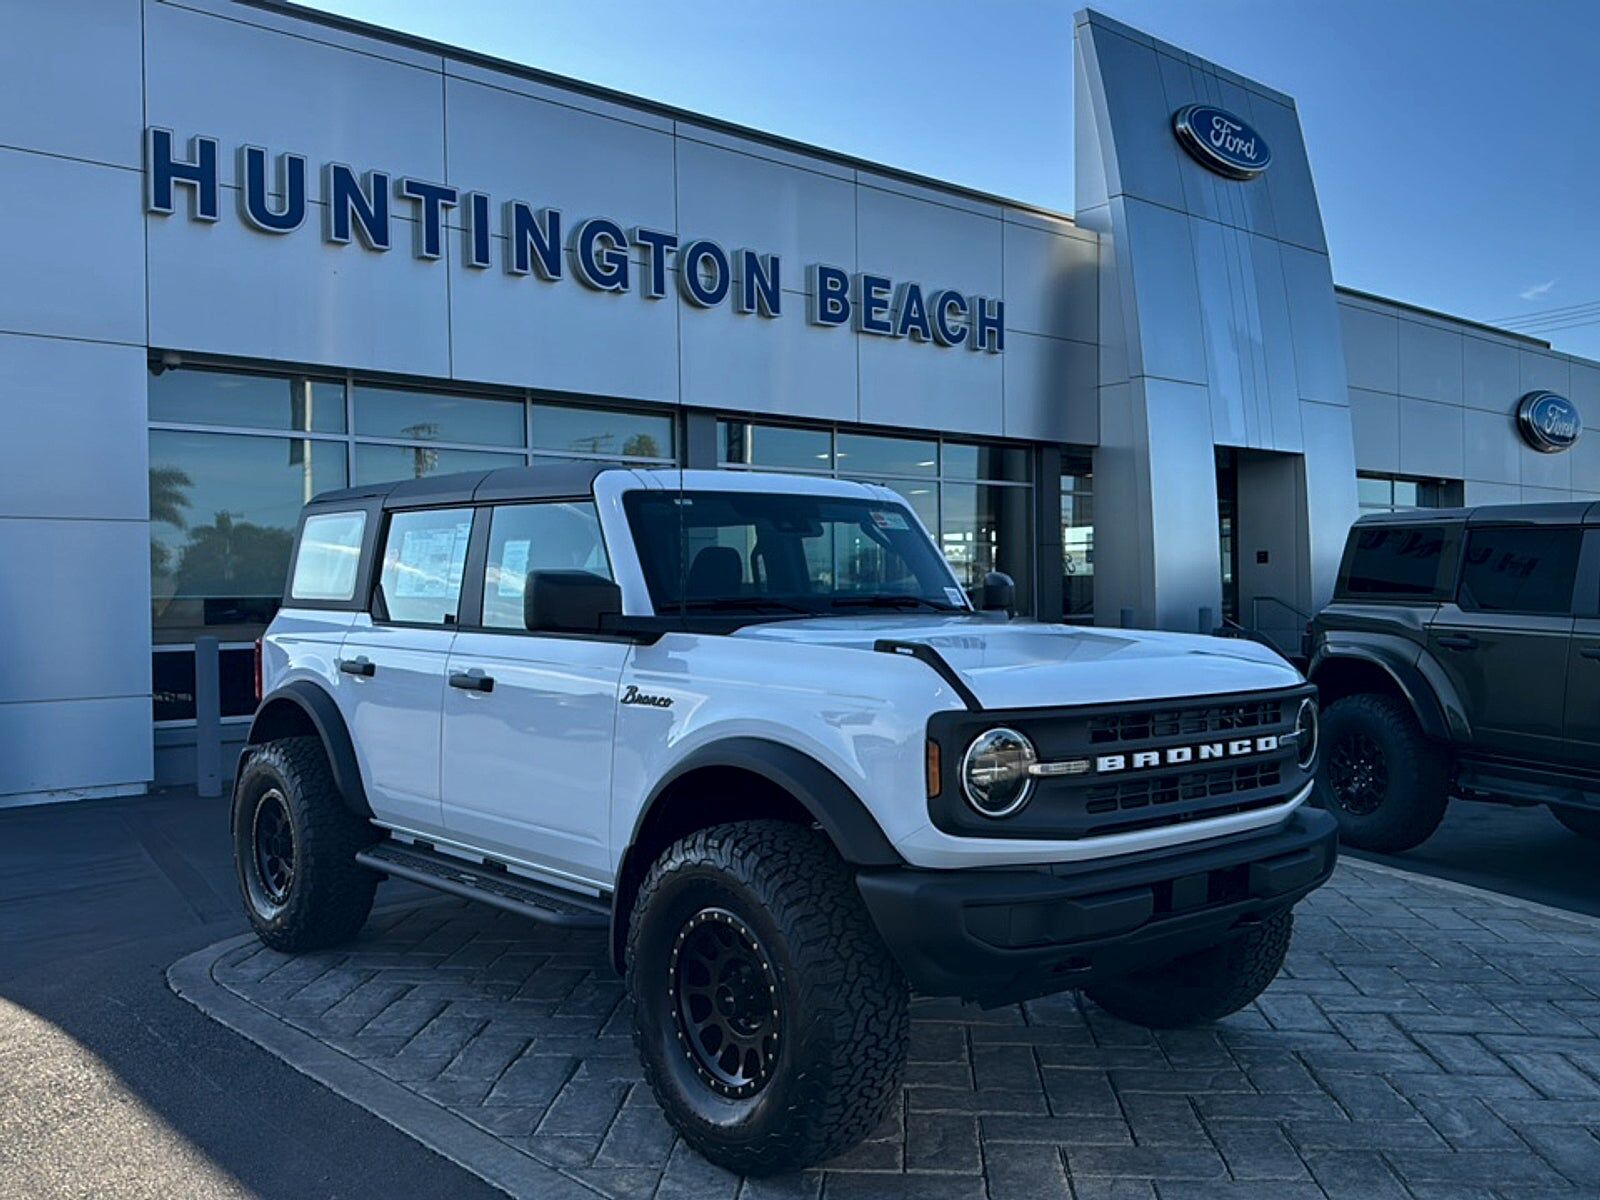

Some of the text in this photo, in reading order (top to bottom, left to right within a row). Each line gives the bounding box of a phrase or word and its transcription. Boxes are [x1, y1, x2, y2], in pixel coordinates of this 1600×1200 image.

[1210, 115, 1258, 160] Ford
[147, 126, 1006, 354] HUNTINGTON BEACH
[620, 685, 674, 708] Bronco
[1096, 735, 1278, 773] BRONCO
